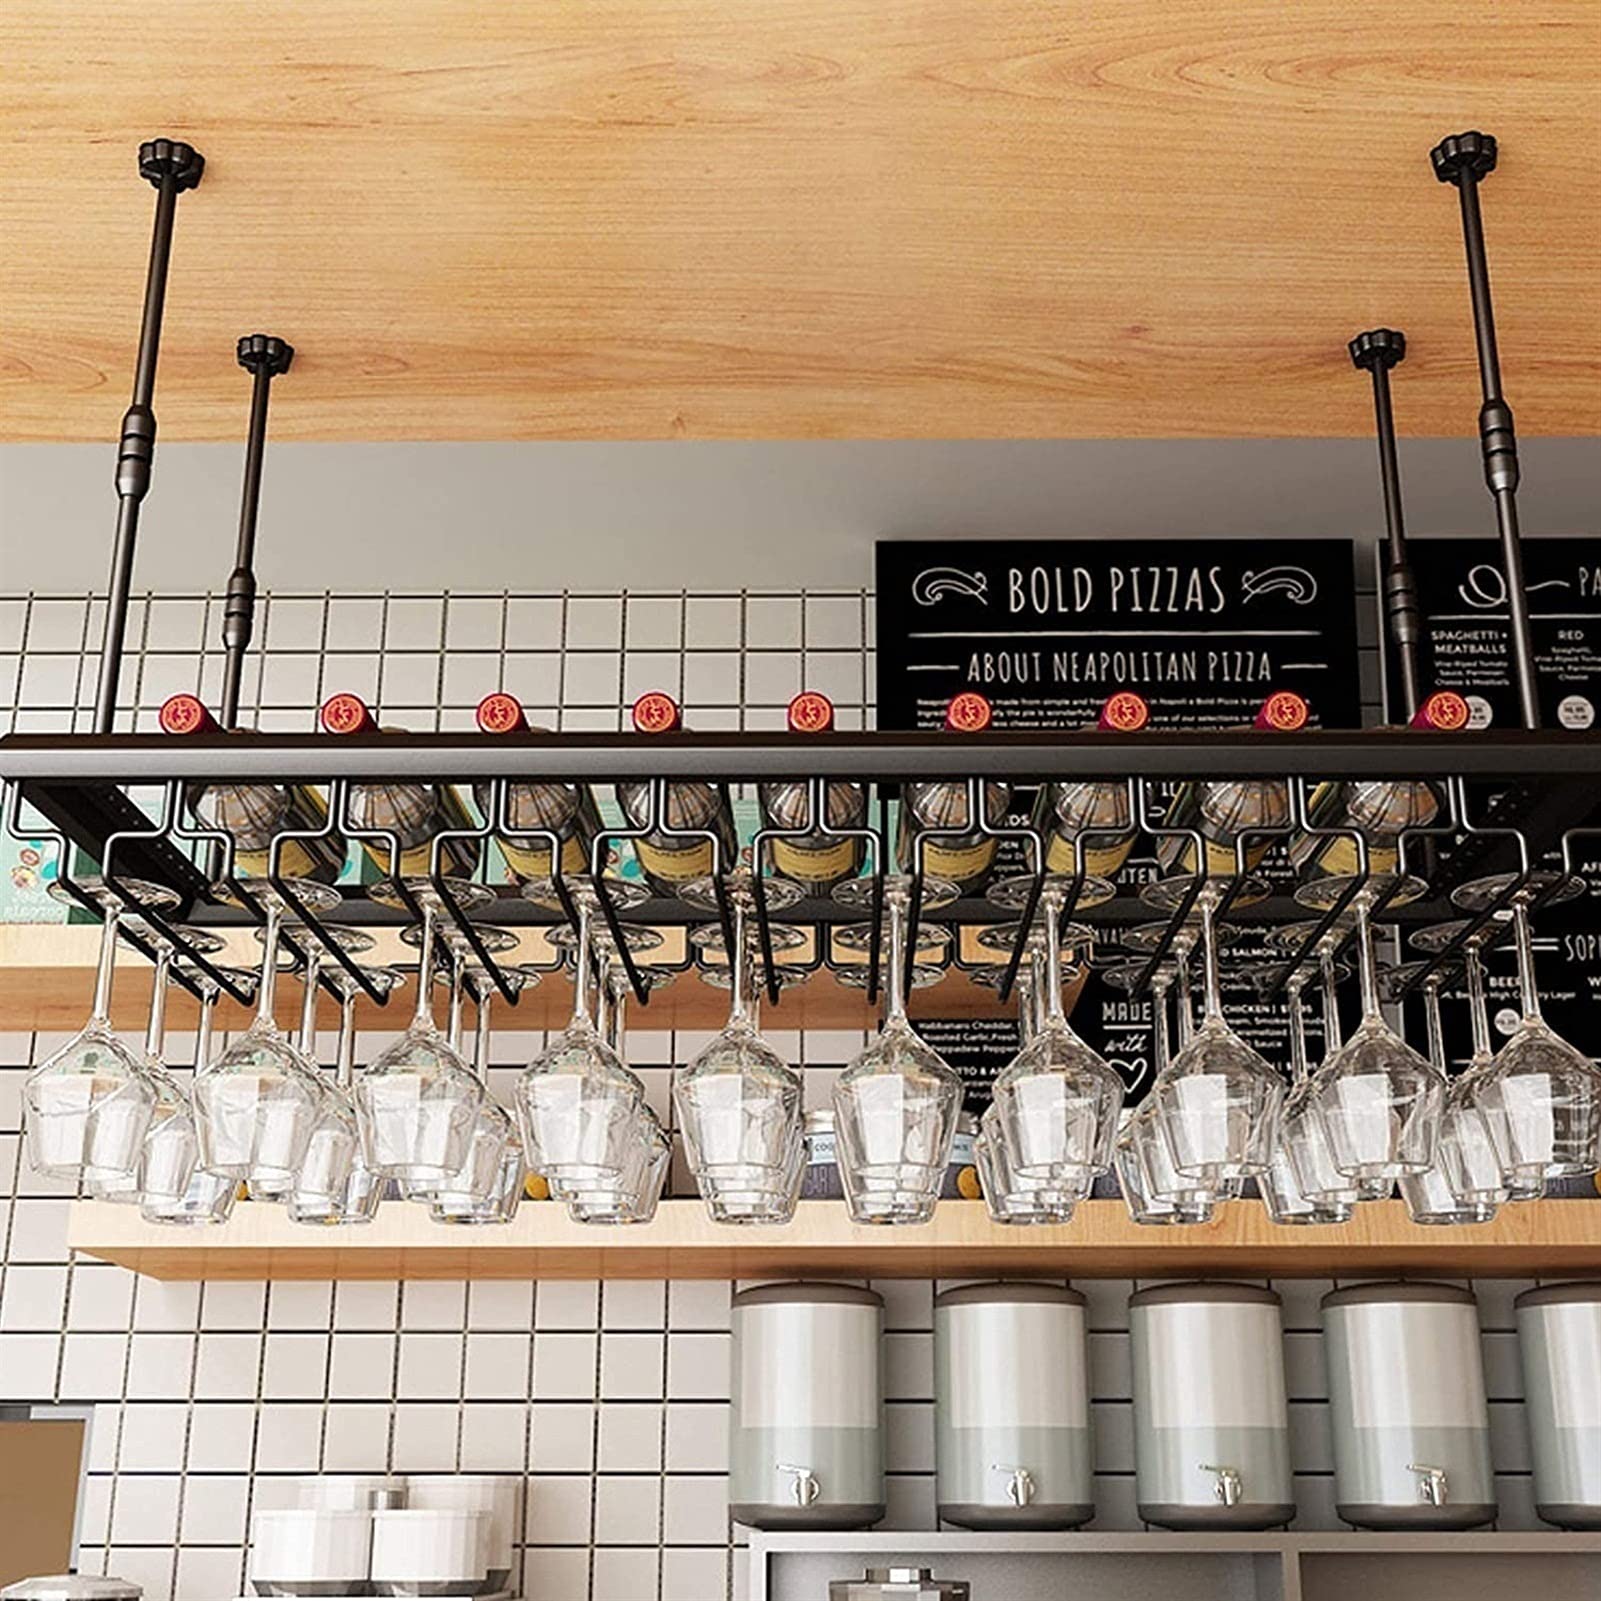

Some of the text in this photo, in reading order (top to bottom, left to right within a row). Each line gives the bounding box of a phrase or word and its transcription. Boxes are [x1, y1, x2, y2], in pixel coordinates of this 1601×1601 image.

[1009, 566, 1225, 614] BOLD PIZZAS
[1431, 630, 1499, 640] SPAGHETTI
[1557, 630, 1584, 640] RED
[1434, 644, 1507, 654] MEATBALLS
[967, 651, 1271, 682] ABOUT NEAPOLITAN PIZZA
[1102, 1002, 1152, 1022] MADE
